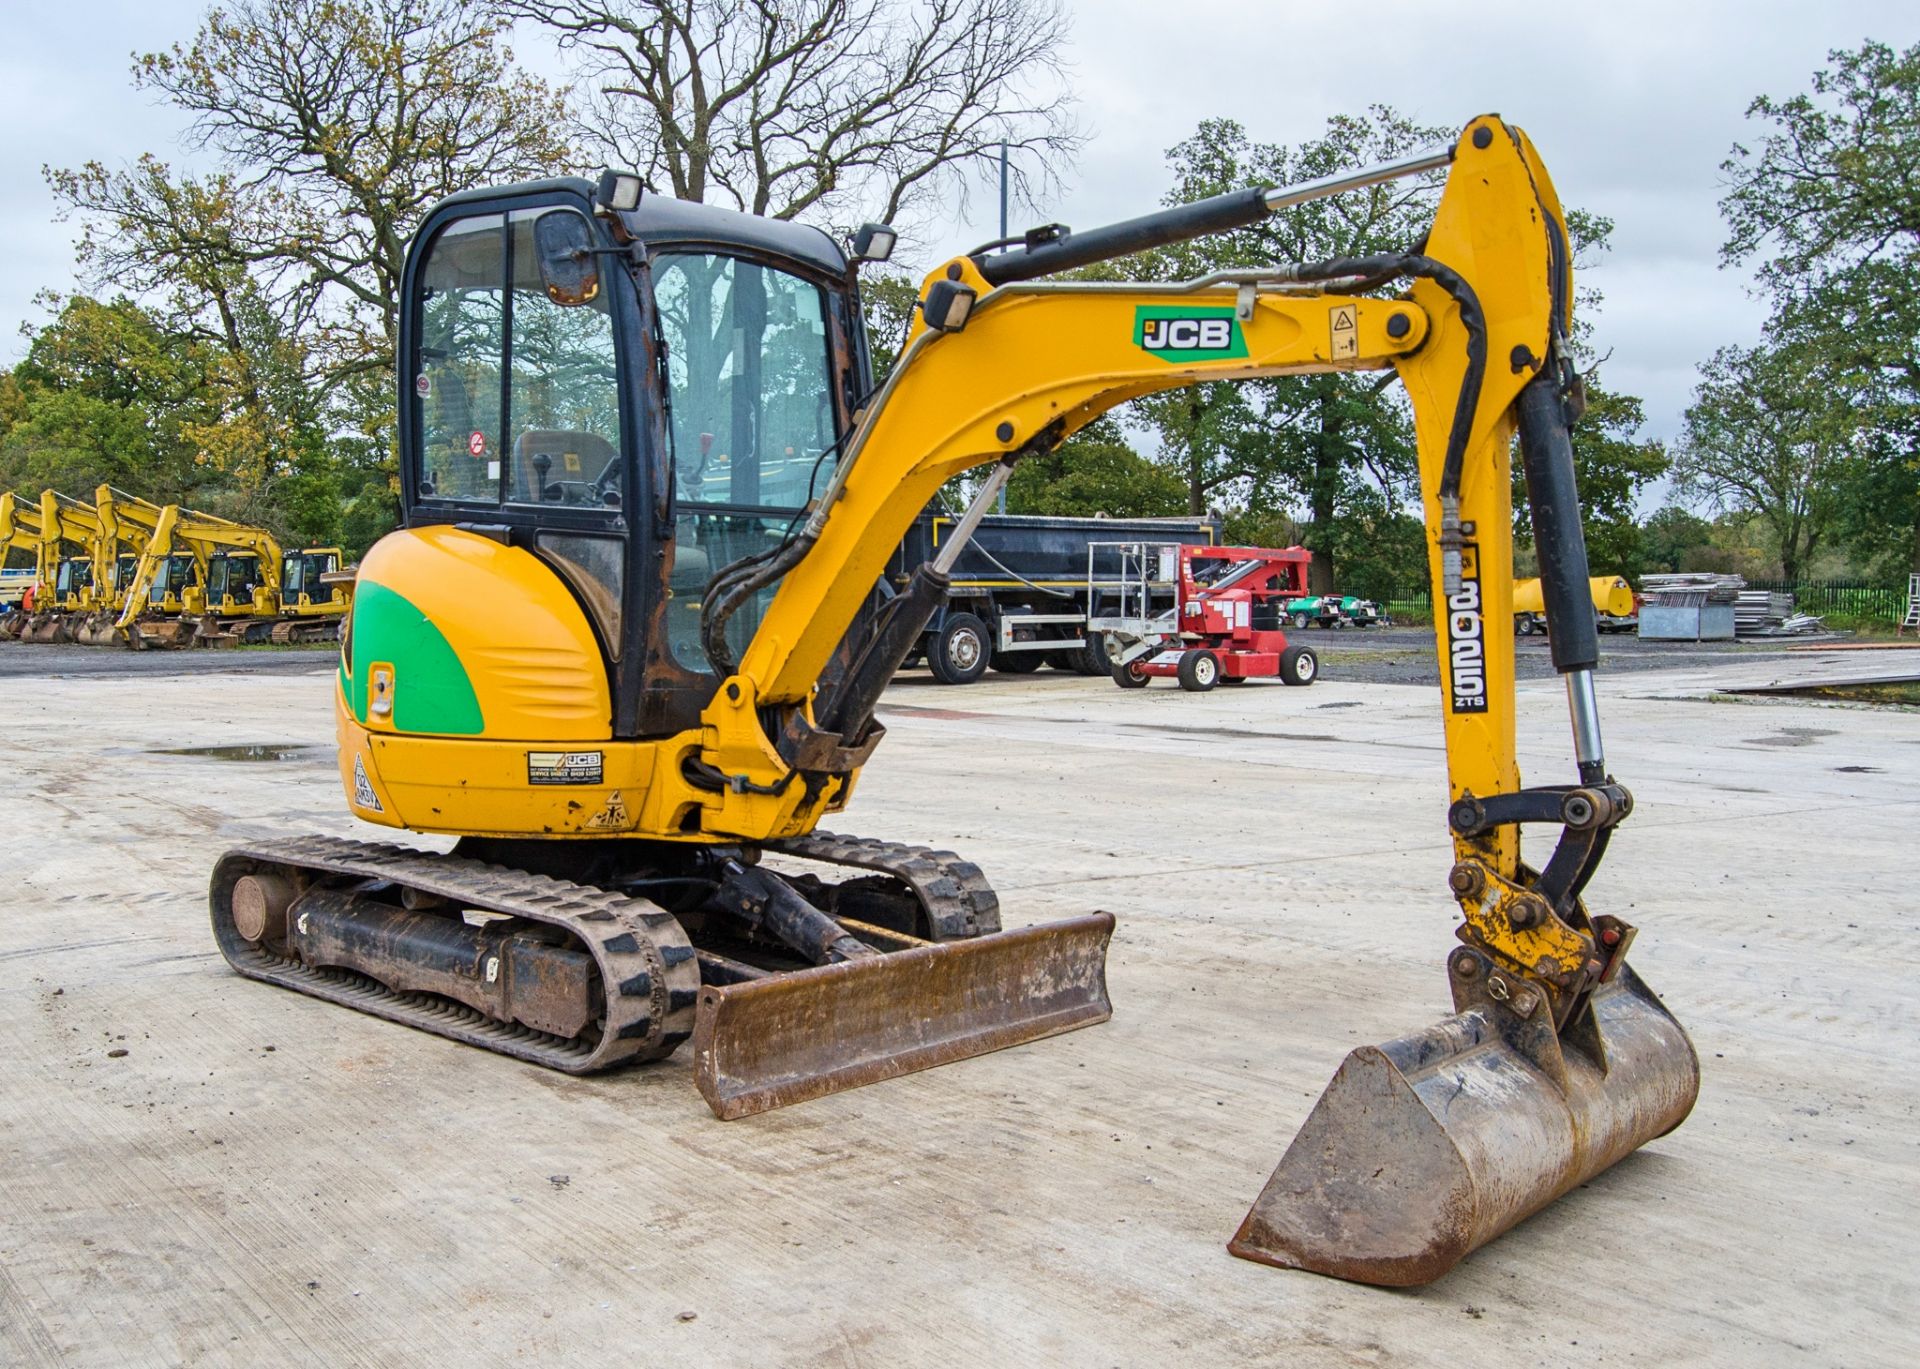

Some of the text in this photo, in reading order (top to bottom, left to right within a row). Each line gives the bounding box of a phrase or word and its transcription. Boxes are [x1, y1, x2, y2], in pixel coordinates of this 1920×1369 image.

[1143, 320, 1230, 349] JCB
[1455, 697, 1485, 707] ZTS
[568, 755, 597, 764] JCB
